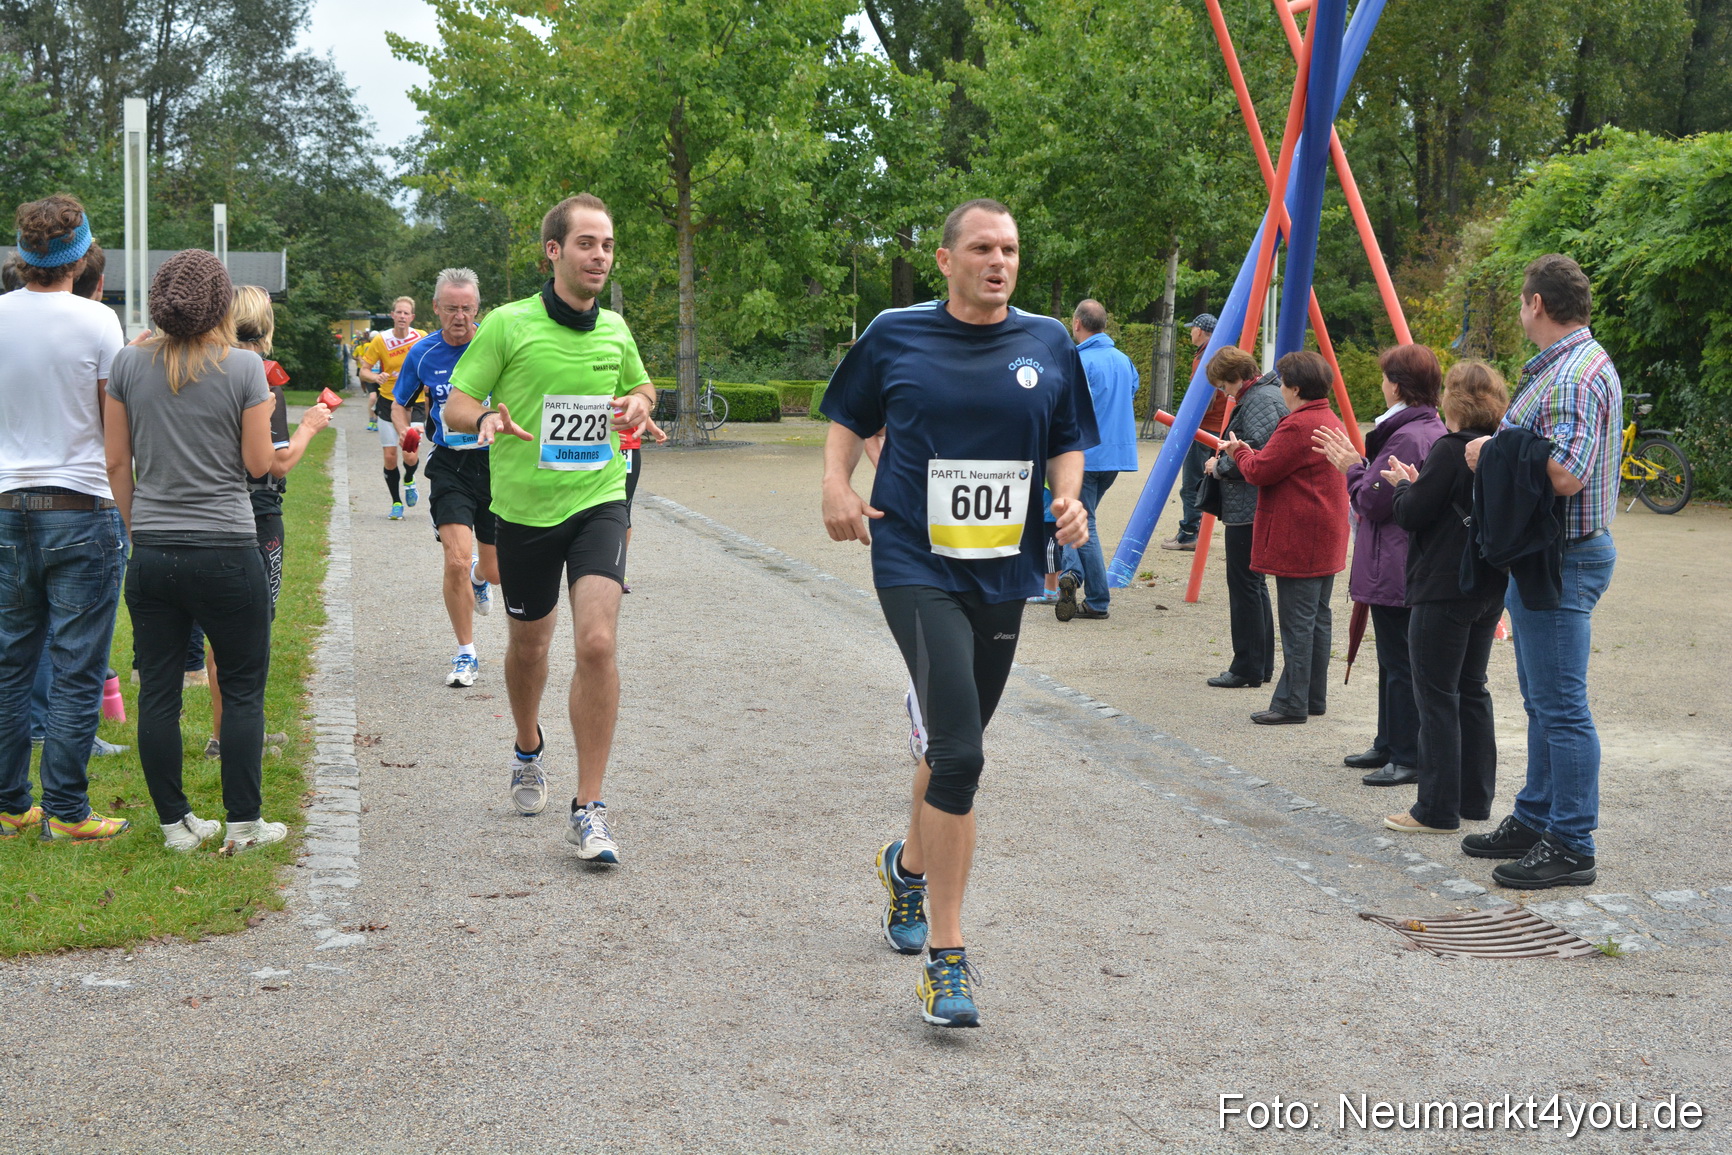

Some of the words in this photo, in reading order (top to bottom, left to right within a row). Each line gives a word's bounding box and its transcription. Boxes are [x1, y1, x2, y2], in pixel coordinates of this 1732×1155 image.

[1008, 356, 1044, 374] adidas
[544, 402, 571, 410] PARTL
[572, 403, 605, 411] Neumarkt
[549, 413, 607, 442] 2223
[555, 448, 600, 460] Johannes
[931, 469, 967, 479] PARTL
[969, 470, 1016, 480] Neumarkt
[951, 484, 1012, 521] 604
